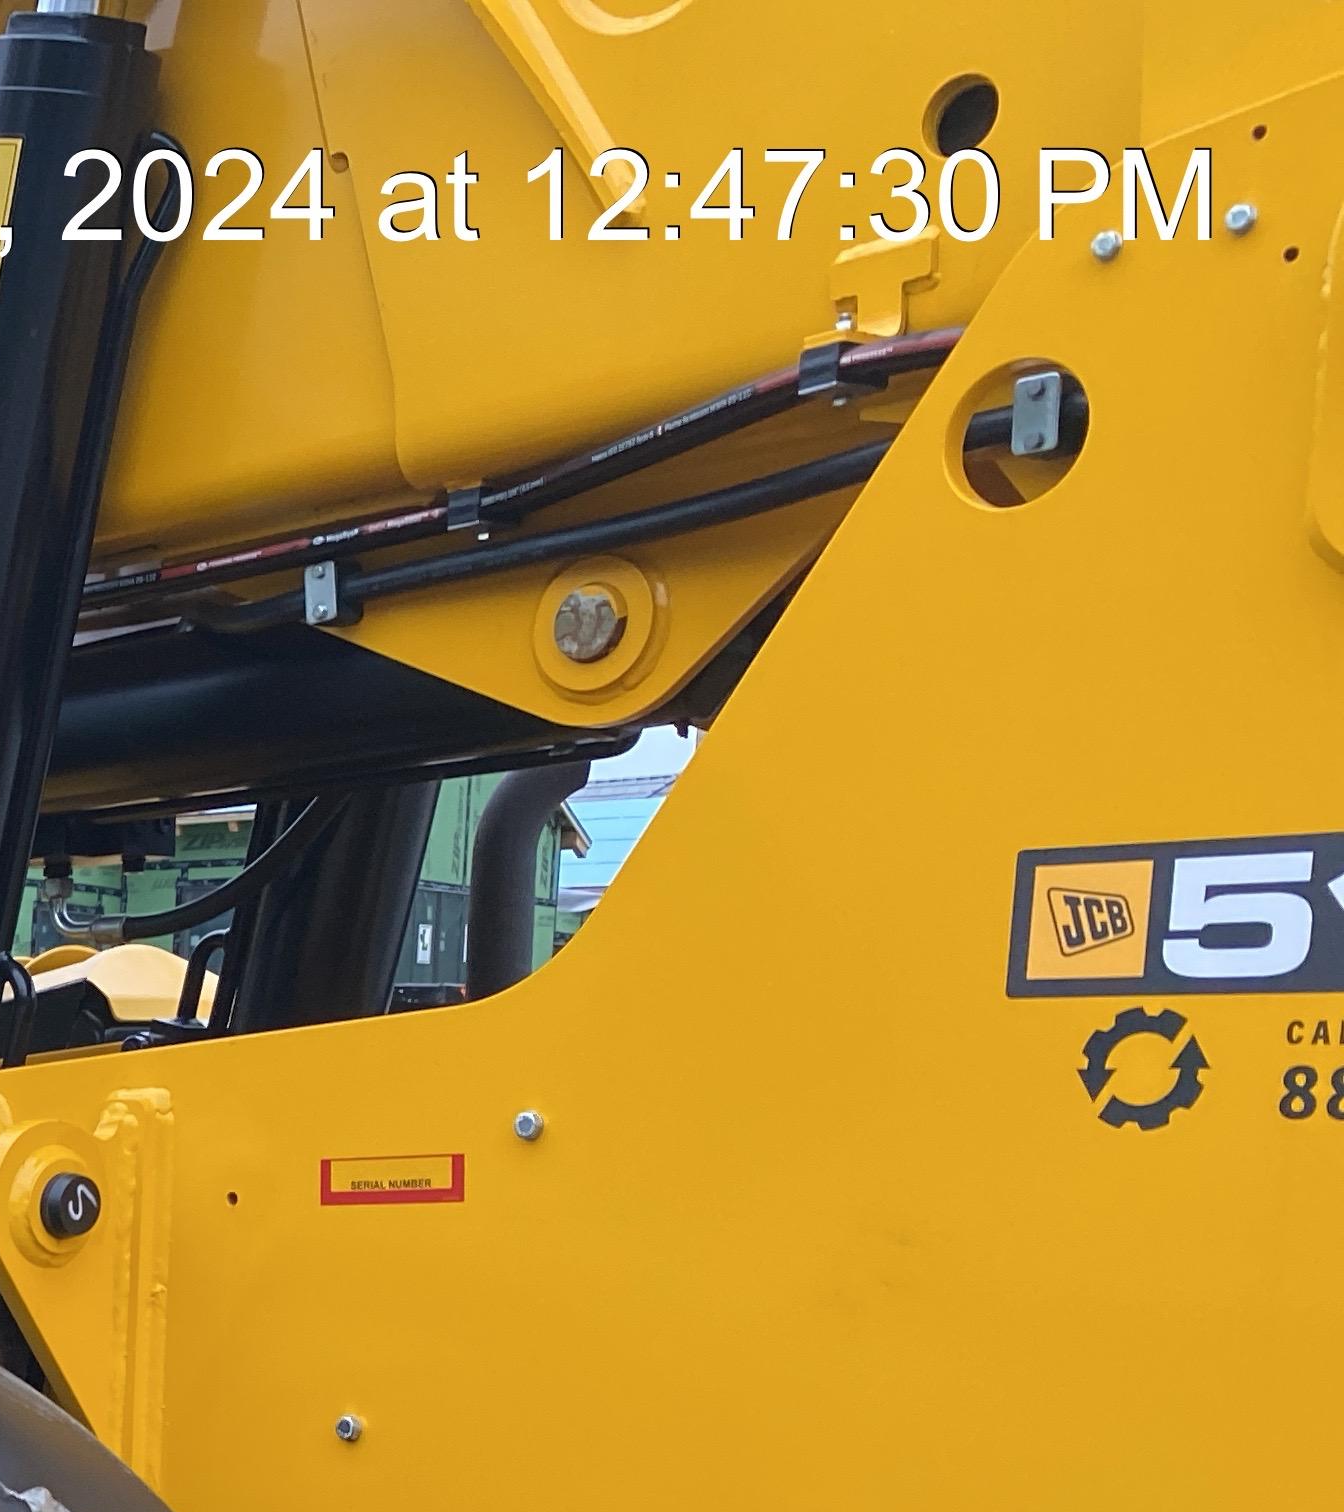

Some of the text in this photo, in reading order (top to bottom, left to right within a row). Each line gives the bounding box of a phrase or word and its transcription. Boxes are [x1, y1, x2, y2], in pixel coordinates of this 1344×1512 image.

[1061, 850, 1344, 979] JCB 5
[1285, 1019, 1344, 1046] CA
[350, 1178, 432, 1191] SERIAL NUMBER
